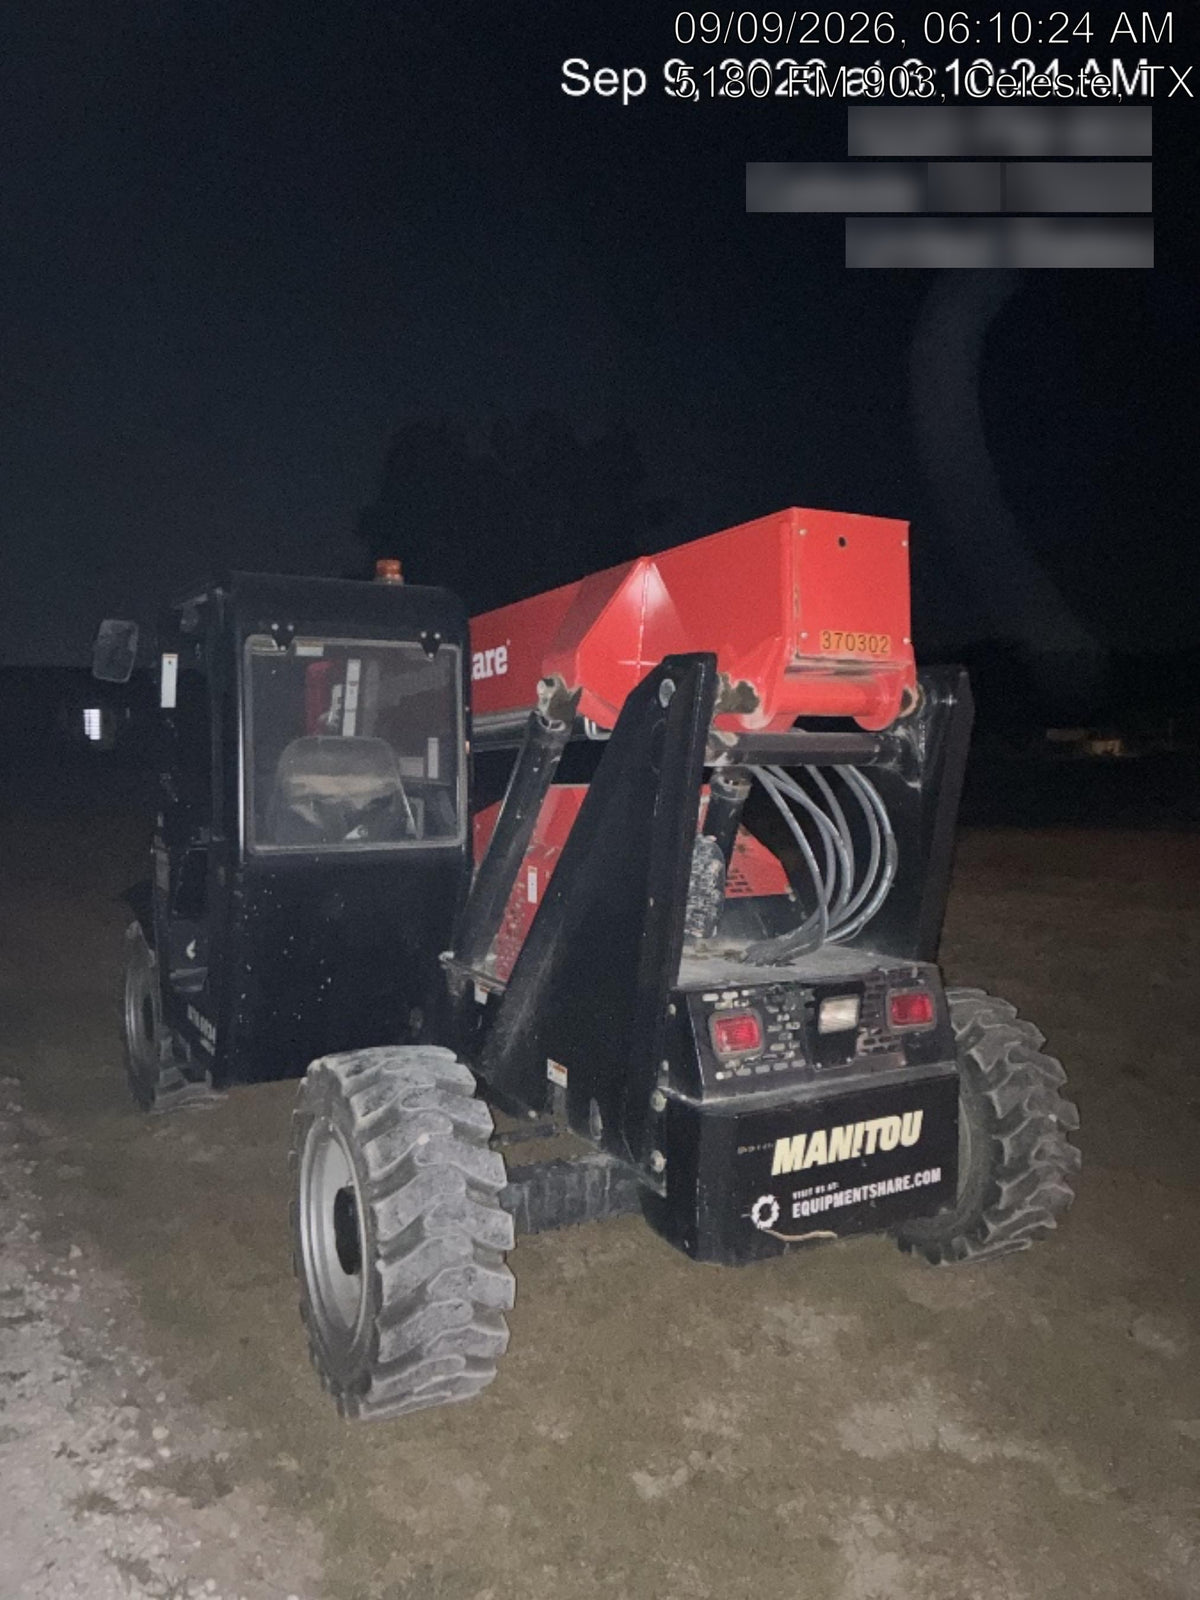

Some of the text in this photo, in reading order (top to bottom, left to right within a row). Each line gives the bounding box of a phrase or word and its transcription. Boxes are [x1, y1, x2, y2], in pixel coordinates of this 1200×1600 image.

[821, 630, 890, 654] 370302
[771, 1110, 924, 1176] MANITOU
[791, 1167, 942, 1219] EQUIPMENTSHARE.COM
